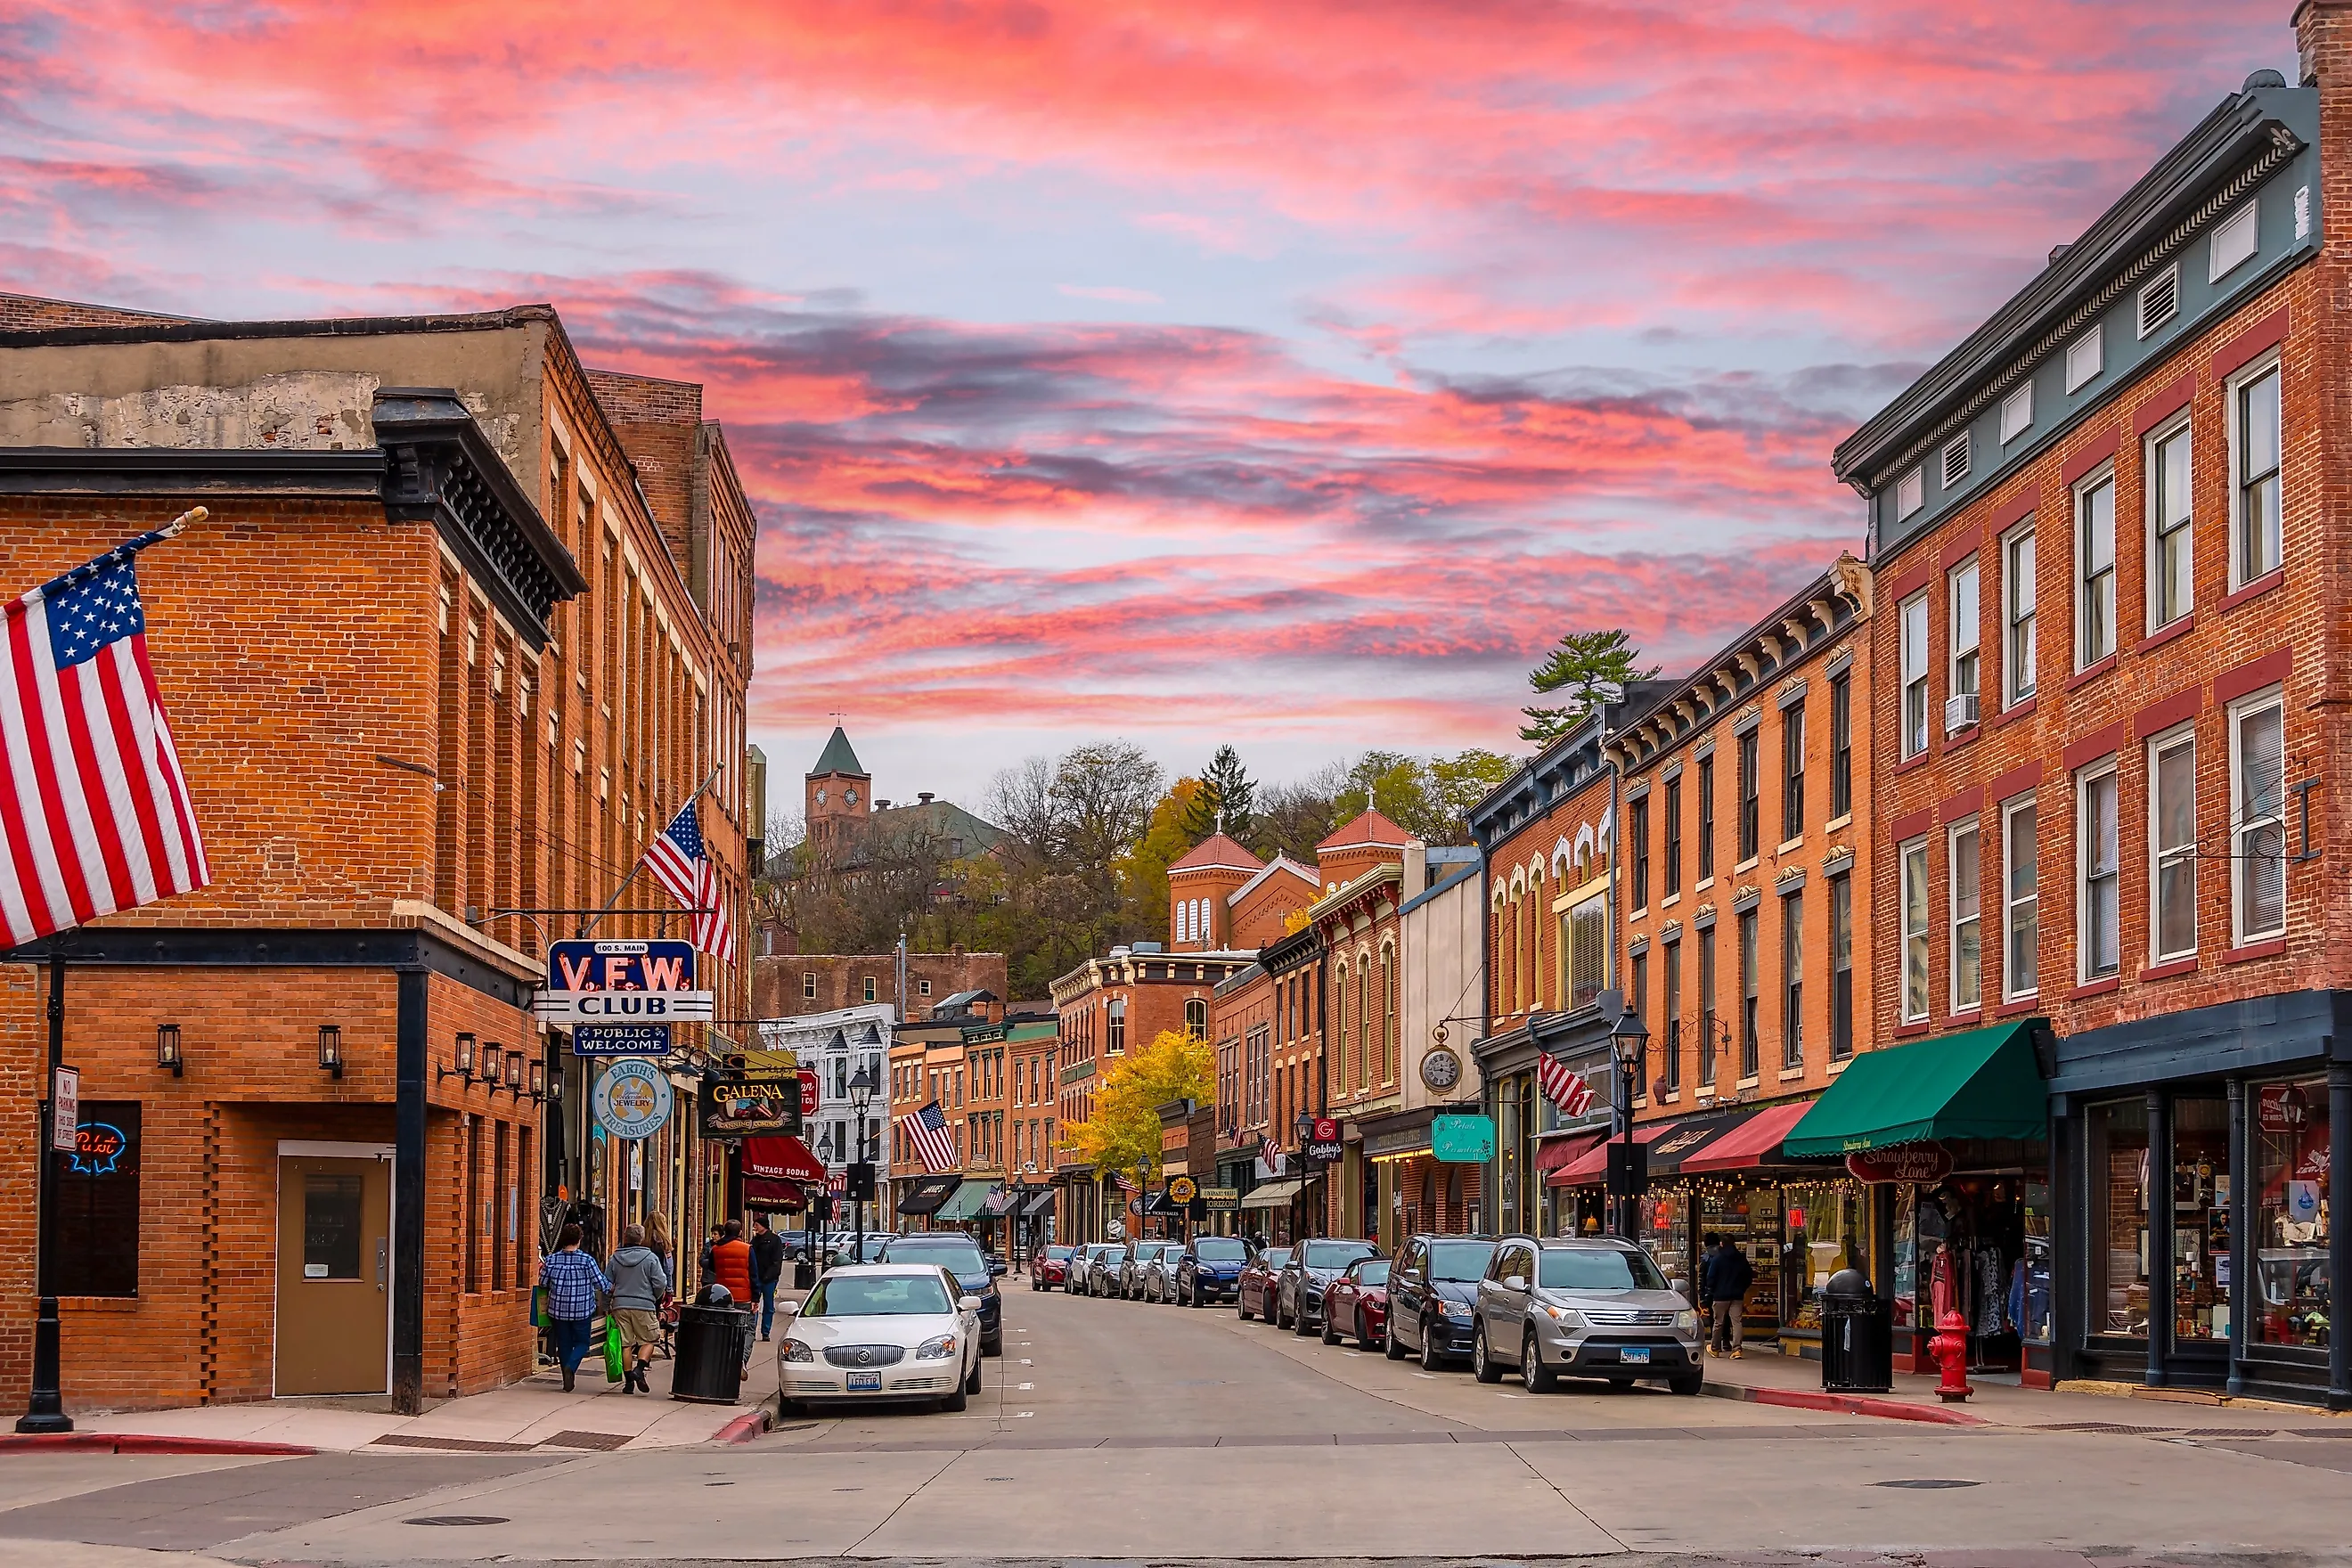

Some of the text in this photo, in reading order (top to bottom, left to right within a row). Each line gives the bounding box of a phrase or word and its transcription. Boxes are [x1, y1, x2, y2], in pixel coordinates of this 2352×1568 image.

[577, 997, 666, 1015] CLUB
[592, 1028, 651, 1038] PUBLIC
[582, 1040, 662, 1050] WELCOME
[610, 1064, 657, 1080] EARTH'S
[63, 1079, 71, 1095] NO
[713, 1083, 785, 1103] GALENA
[601, 1111, 663, 1136] TREASURES
[1450, 1118, 1475, 1130] Petals
[1309, 1142, 1343, 1159] Gabby's
[1864, 1146, 1939, 1172] Strawberry
[753, 1164, 810, 1177] VINTAGE SODAS
[1895, 1161, 1931, 1179] Lane
